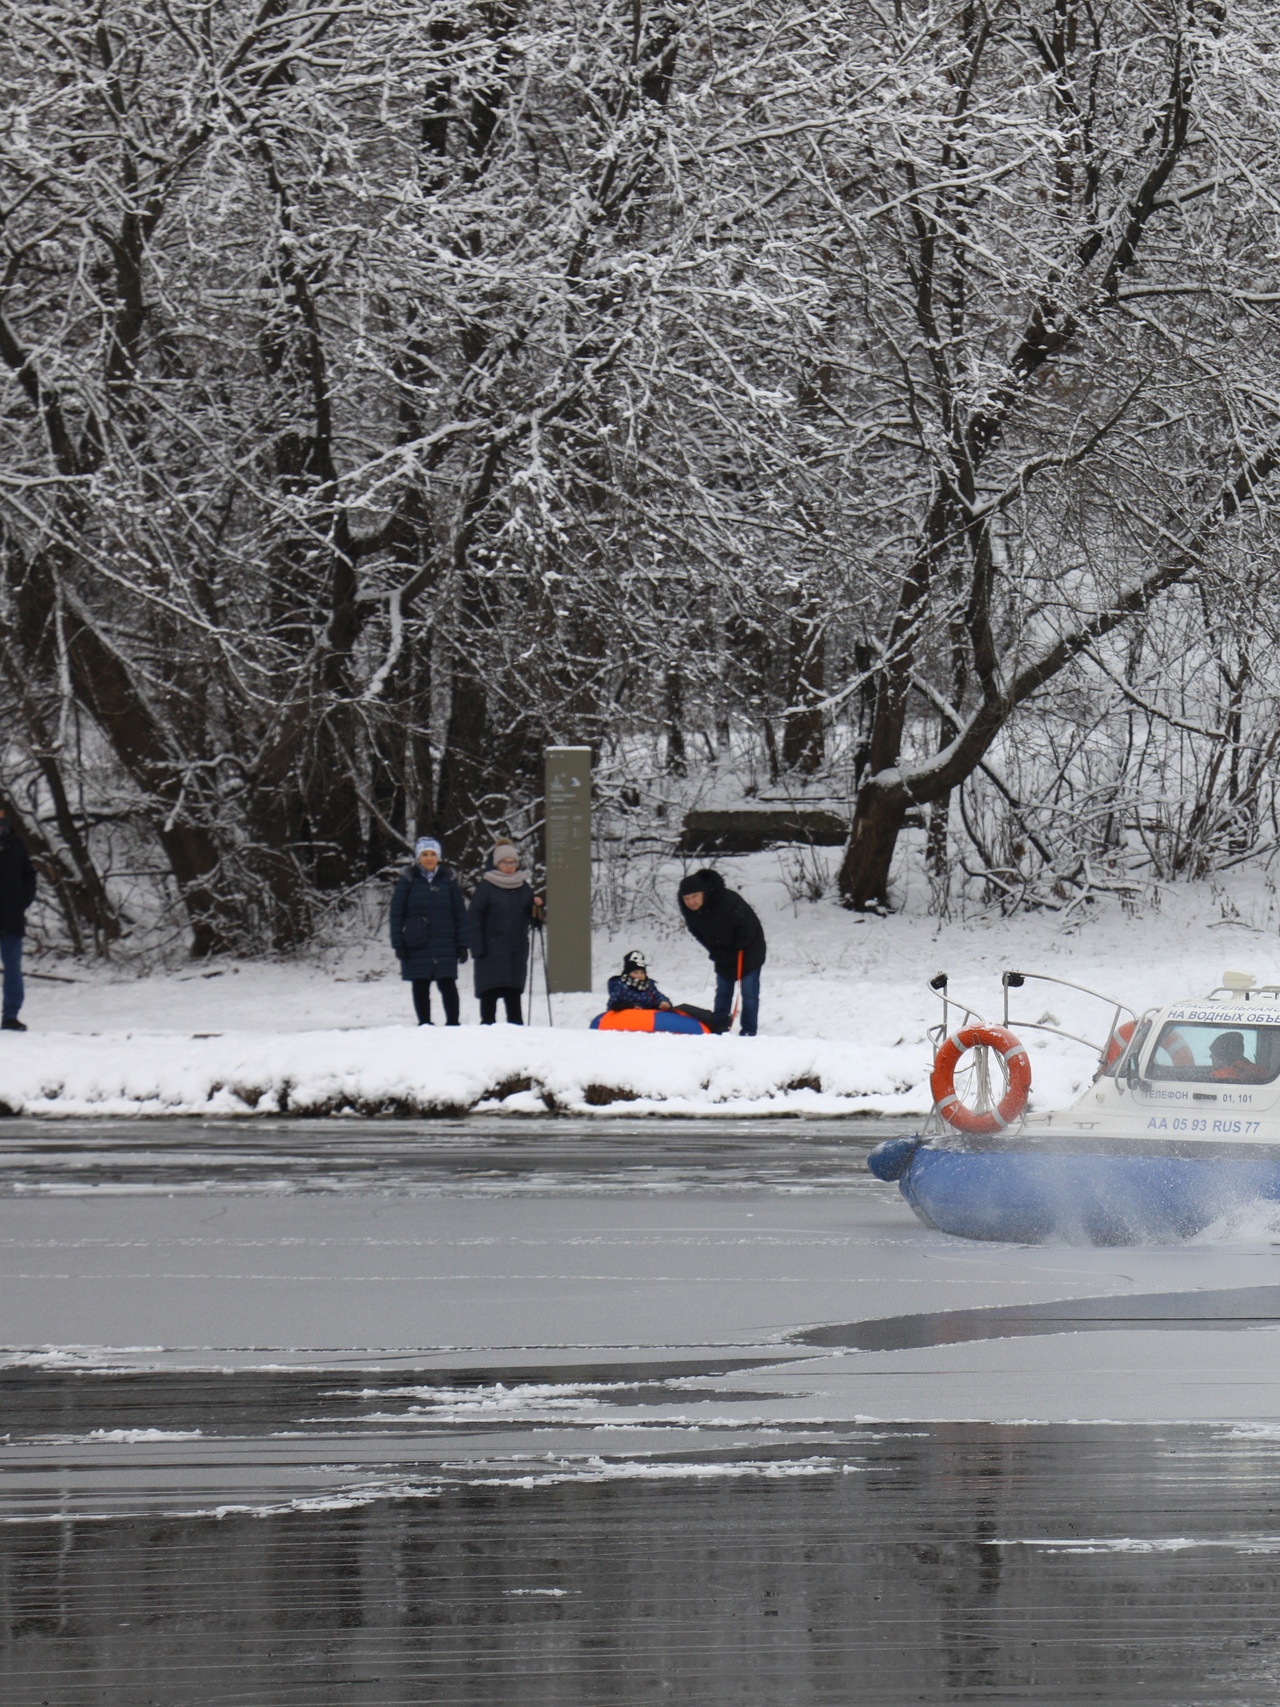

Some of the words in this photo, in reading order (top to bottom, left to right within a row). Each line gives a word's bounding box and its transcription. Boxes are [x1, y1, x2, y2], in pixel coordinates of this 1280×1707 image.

[1172, 1003, 1273, 1012] СПАСАТЕЛЬНАЯ
[1167, 1010, 1185, 1019] НА
[1188, 1011, 1245, 1022] ВОДНЫХ
[1222, 1094, 1236, 1104] 01,
[1238, 1094, 1253, 1103] 101
[1172, 1118, 1188, 1131] 05
[1191, 1119, 1207, 1132] 93
[1212, 1120, 1242, 1133] RUS
[1245, 1121, 1261, 1134] 77
